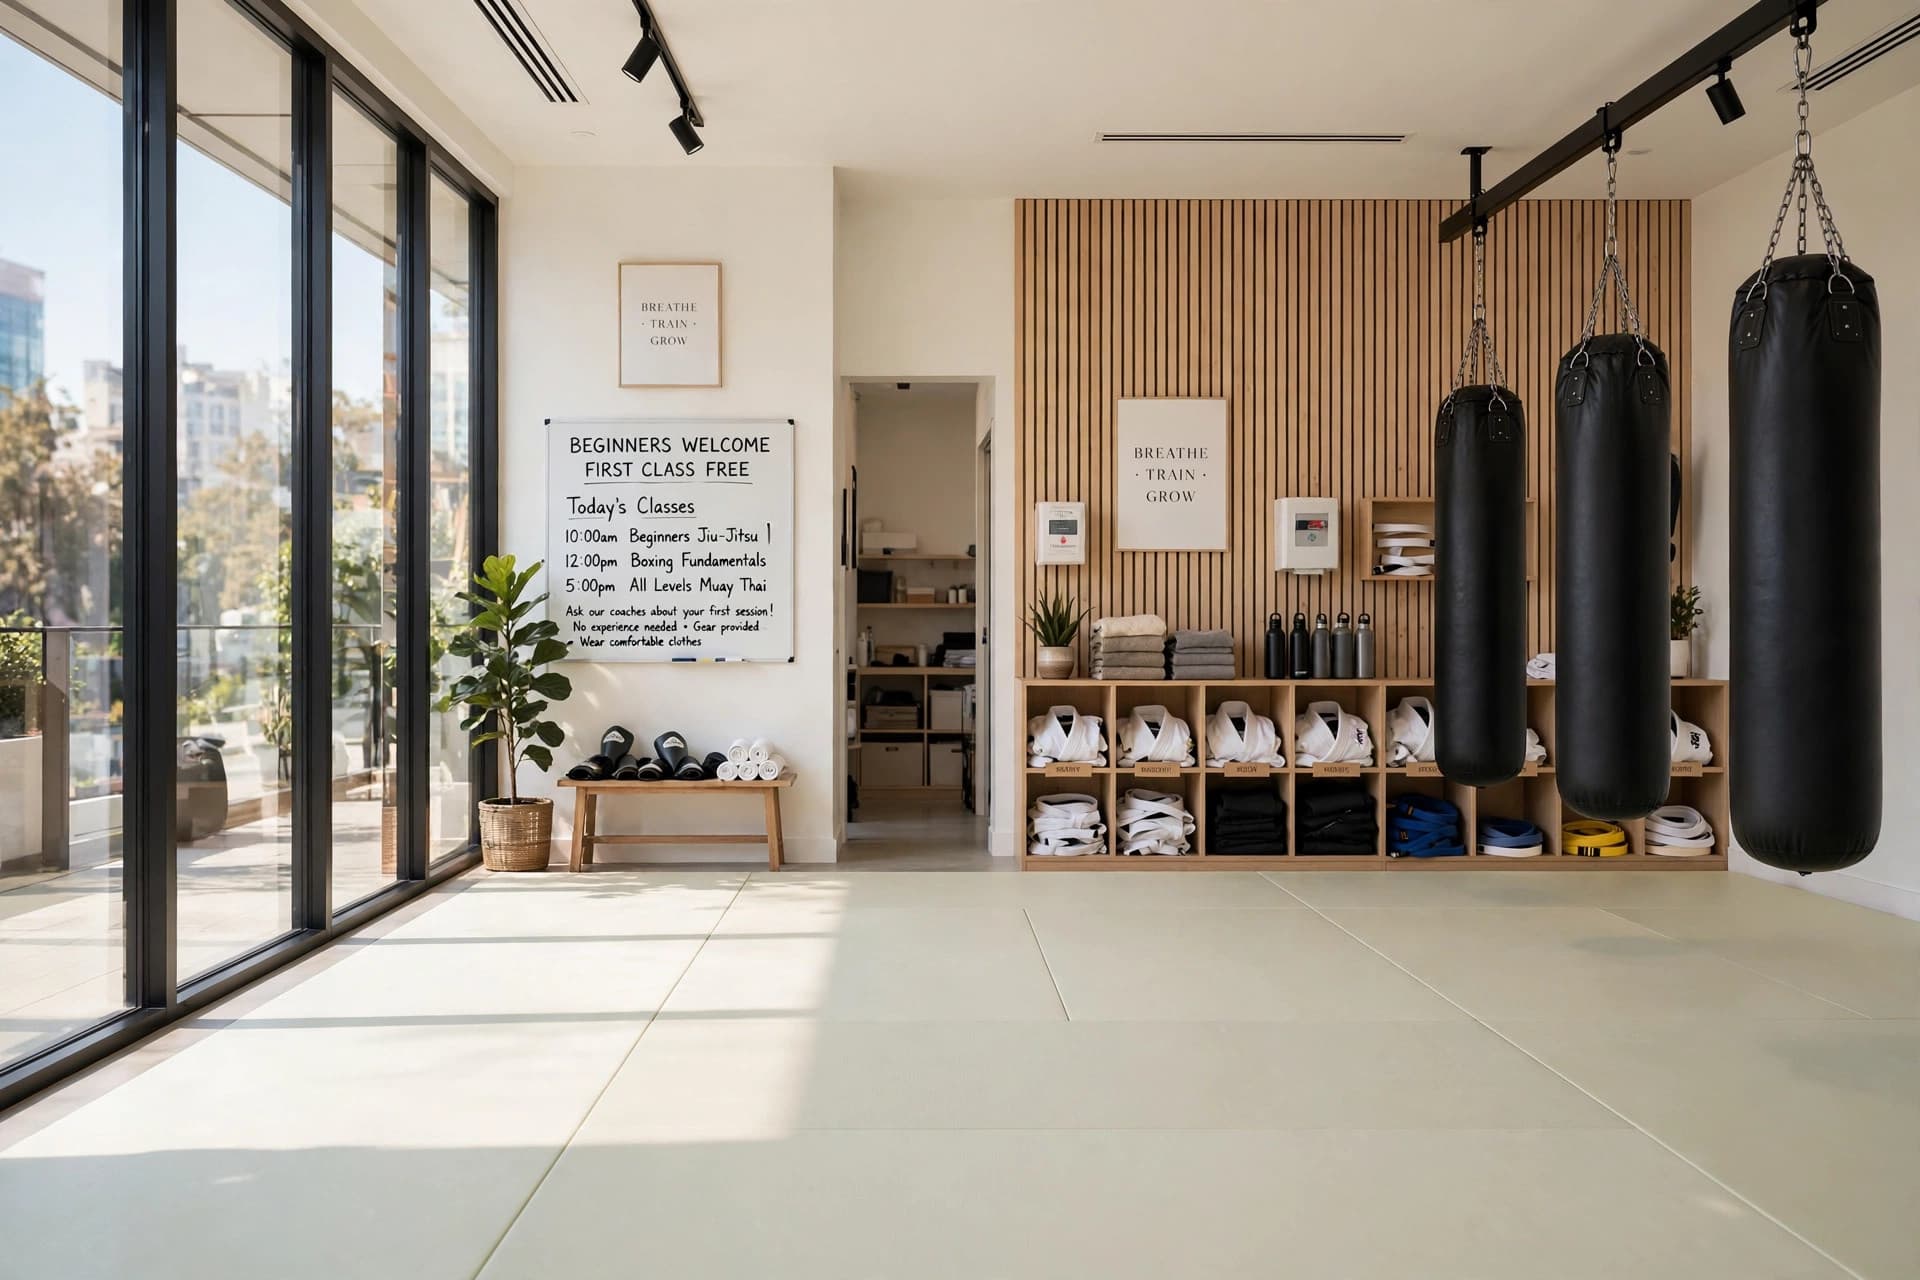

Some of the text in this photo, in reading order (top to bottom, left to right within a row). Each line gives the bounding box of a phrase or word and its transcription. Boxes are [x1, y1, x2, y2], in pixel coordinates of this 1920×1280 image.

[641, 302, 698, 312] BREATHE
[650, 319, 687, 329] TRAIN
[650, 336, 688, 345] GROW
[570, 437, 771, 454] BEGINNERS WELCOME
[1134, 447, 1208, 459] BREATHE
[585, 462, 750, 478] FIRST CLASS FREE
[1145, 468, 1195, 481] TRAIN
[1146, 490, 1196, 502] GROW
[566, 496, 695, 523] Today's Classes
[565, 529, 618, 544] 10:00am
[629, 528, 691, 549] Beginners
[697, 527, 759, 543] Jiu-Jitsu
[565, 552, 767, 574] 12:00pm Boxing Fundamentals
[565, 577, 767, 599] 5:00pm All Levels Muay Thai
[565, 605, 585, 617] Ask
[609, 606, 647, 617] coaches
[650, 605, 677, 617] about
[682, 610, 705, 620] your
[709, 605, 731, 617] first
[573, 620, 760, 636] No experience needed Gear provided
[579, 635, 702, 648] Wear comfortable clothes
